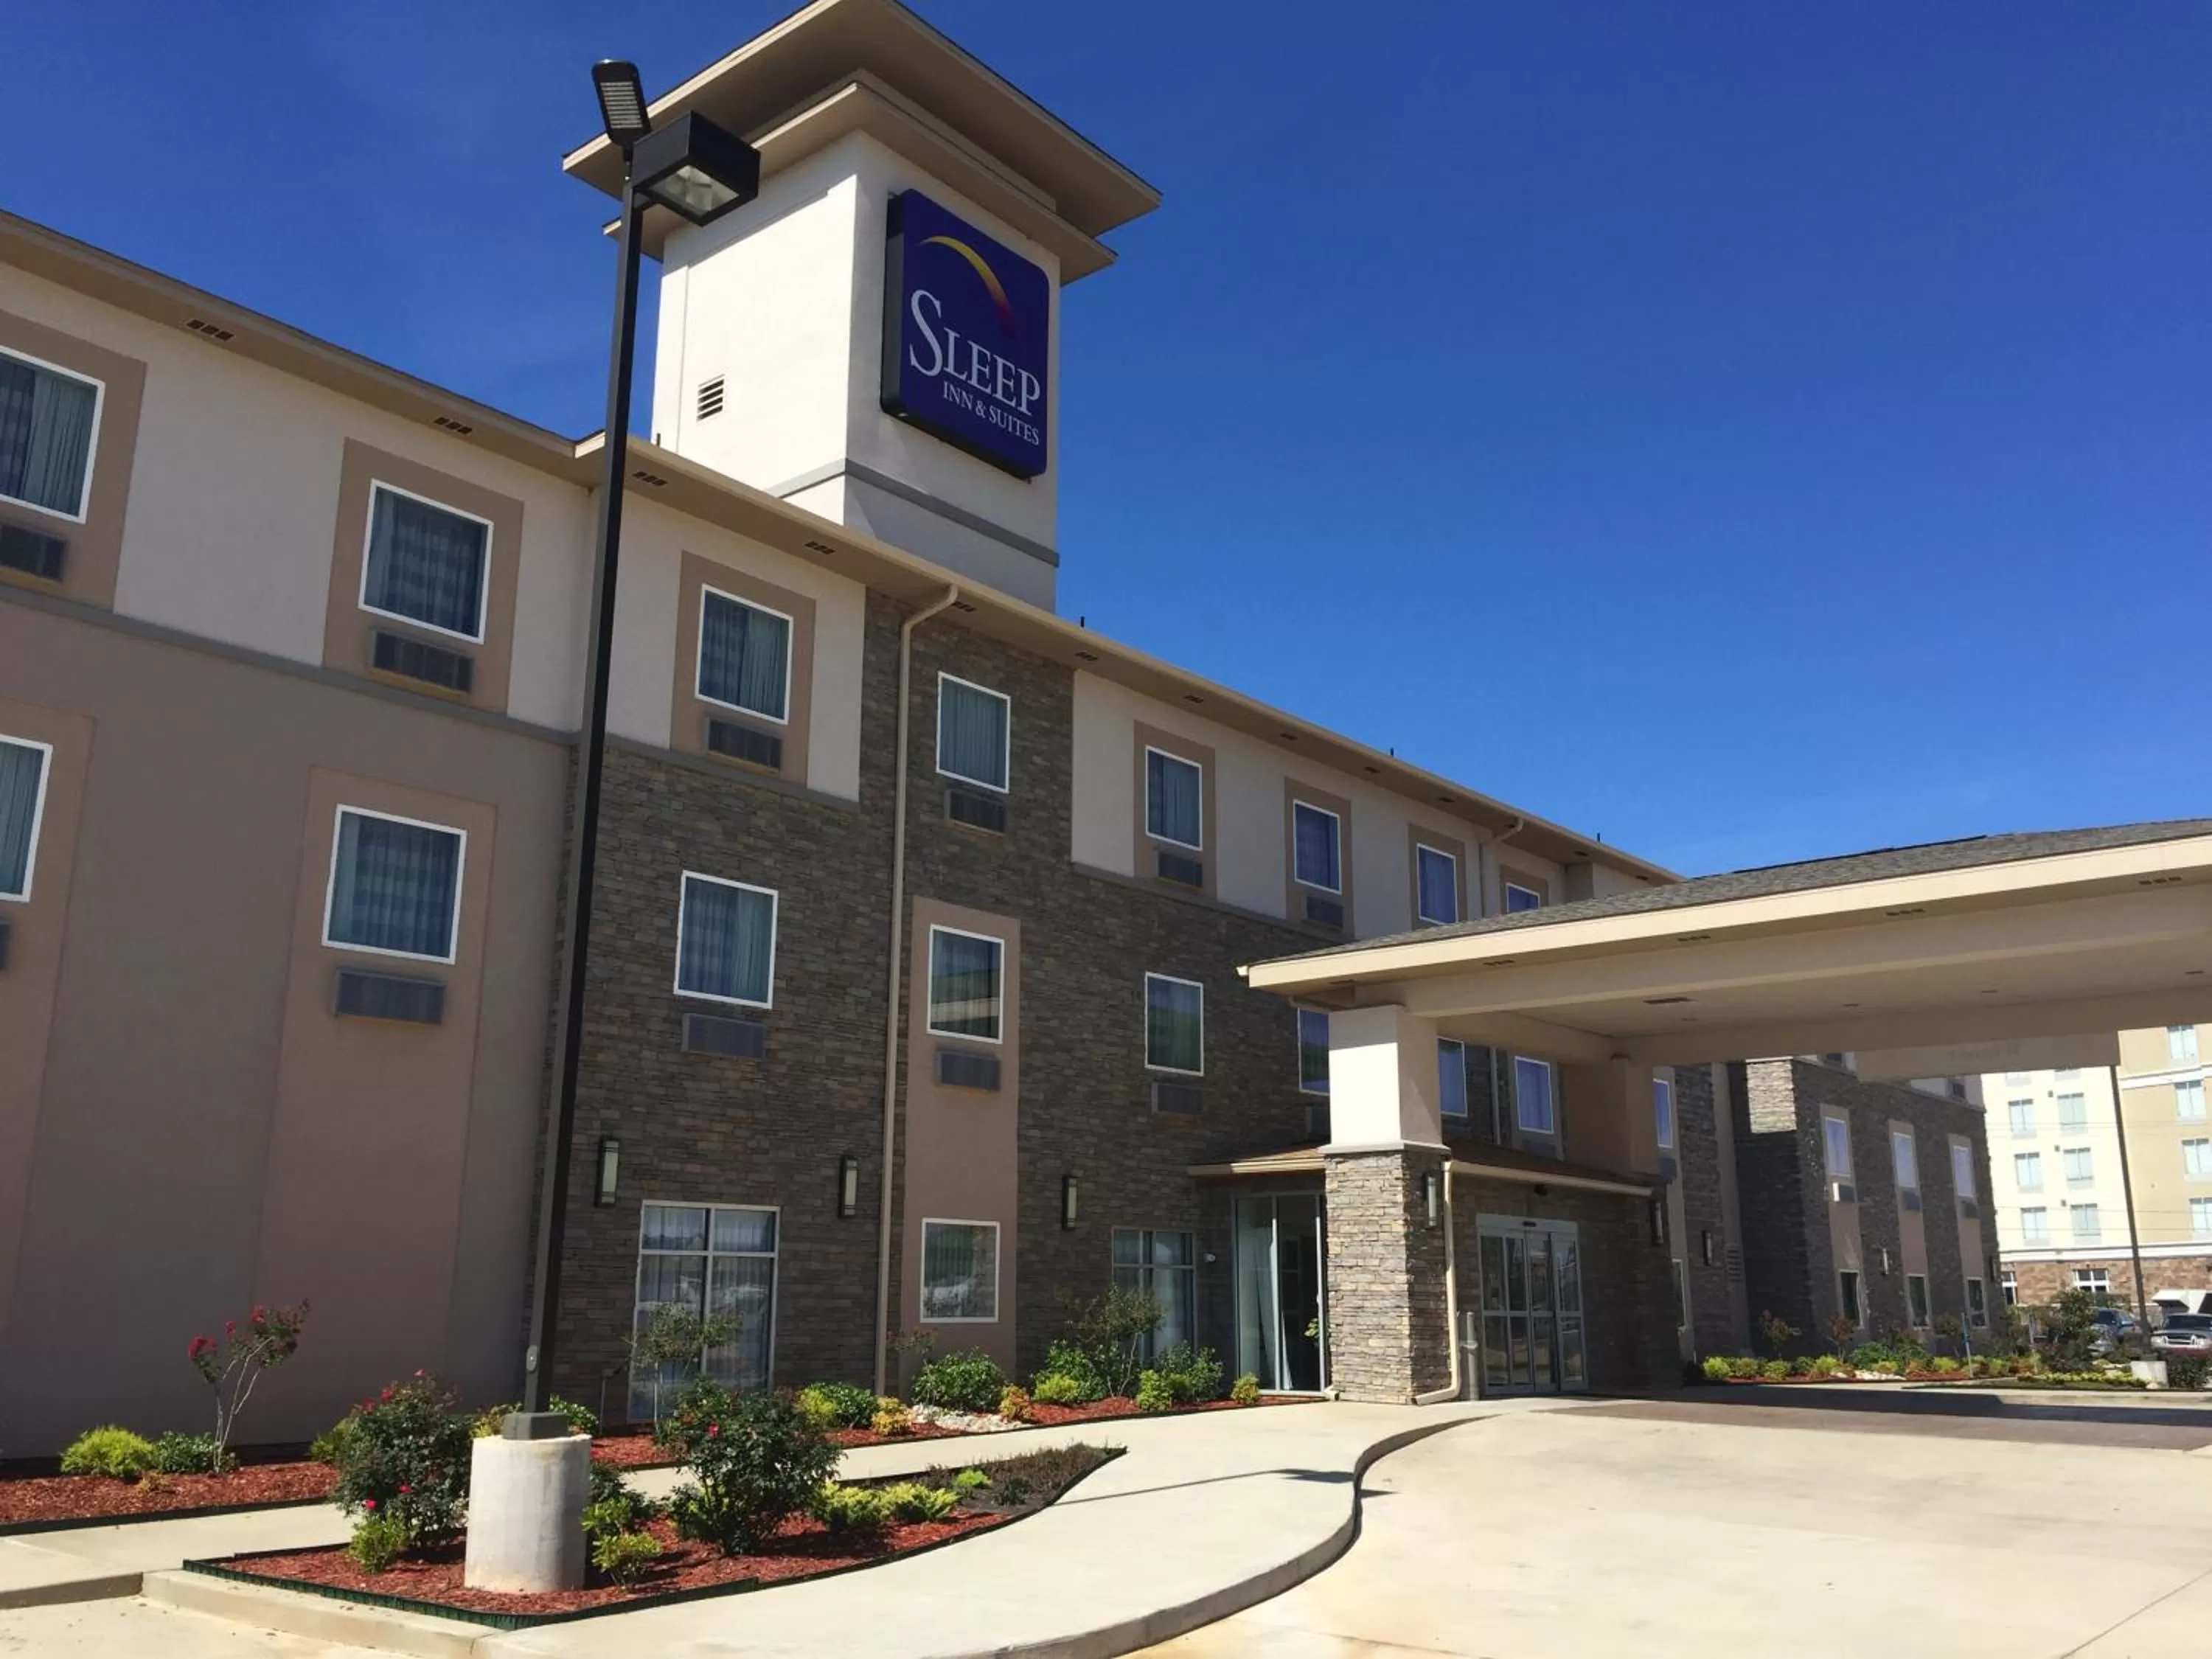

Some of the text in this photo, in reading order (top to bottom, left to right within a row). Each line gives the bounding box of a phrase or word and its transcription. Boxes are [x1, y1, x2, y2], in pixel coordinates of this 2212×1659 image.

[909, 289, 1040, 416] SLEEP
[943, 380, 1039, 446] INN & SUITES
